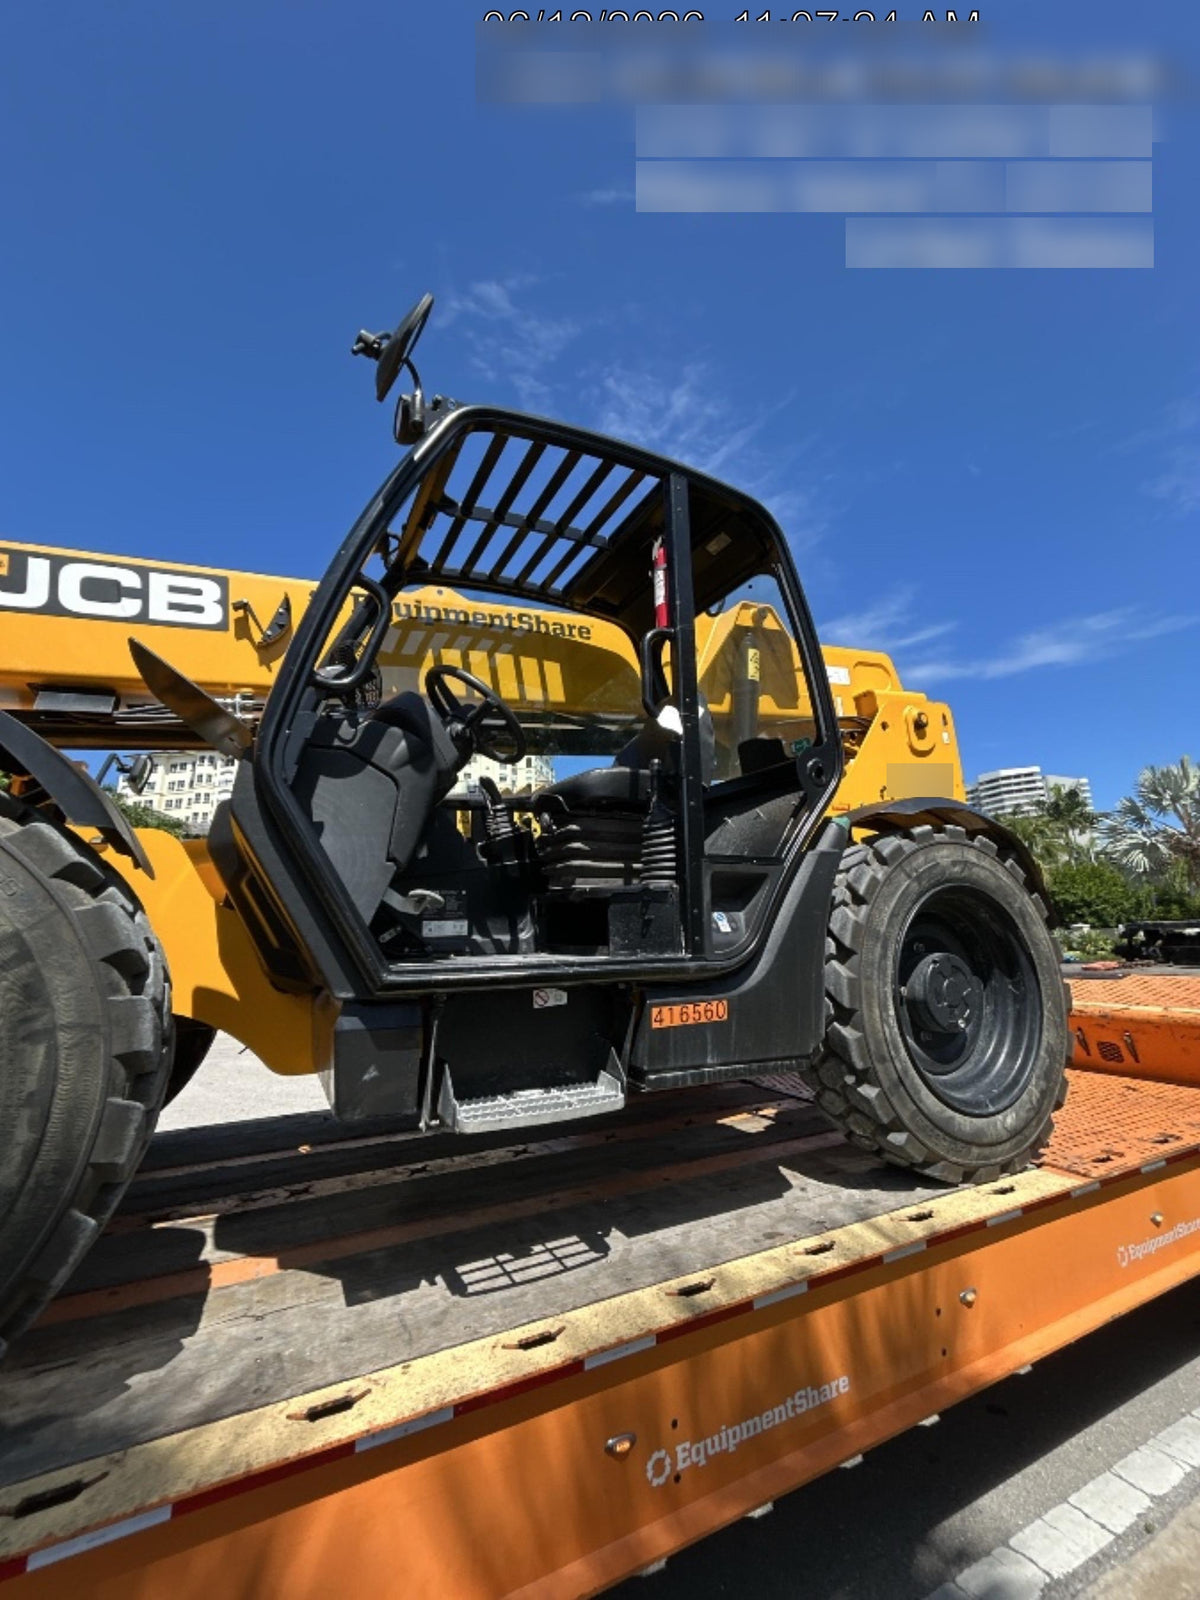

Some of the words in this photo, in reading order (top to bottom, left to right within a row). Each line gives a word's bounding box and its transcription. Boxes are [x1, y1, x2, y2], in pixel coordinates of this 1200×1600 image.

[0, 556, 224, 625] JCB
[350, 592, 592, 641] uipmentShare
[653, 1000, 726, 1026] 416560
[675, 1375, 850, 1471] EquipmentShare
